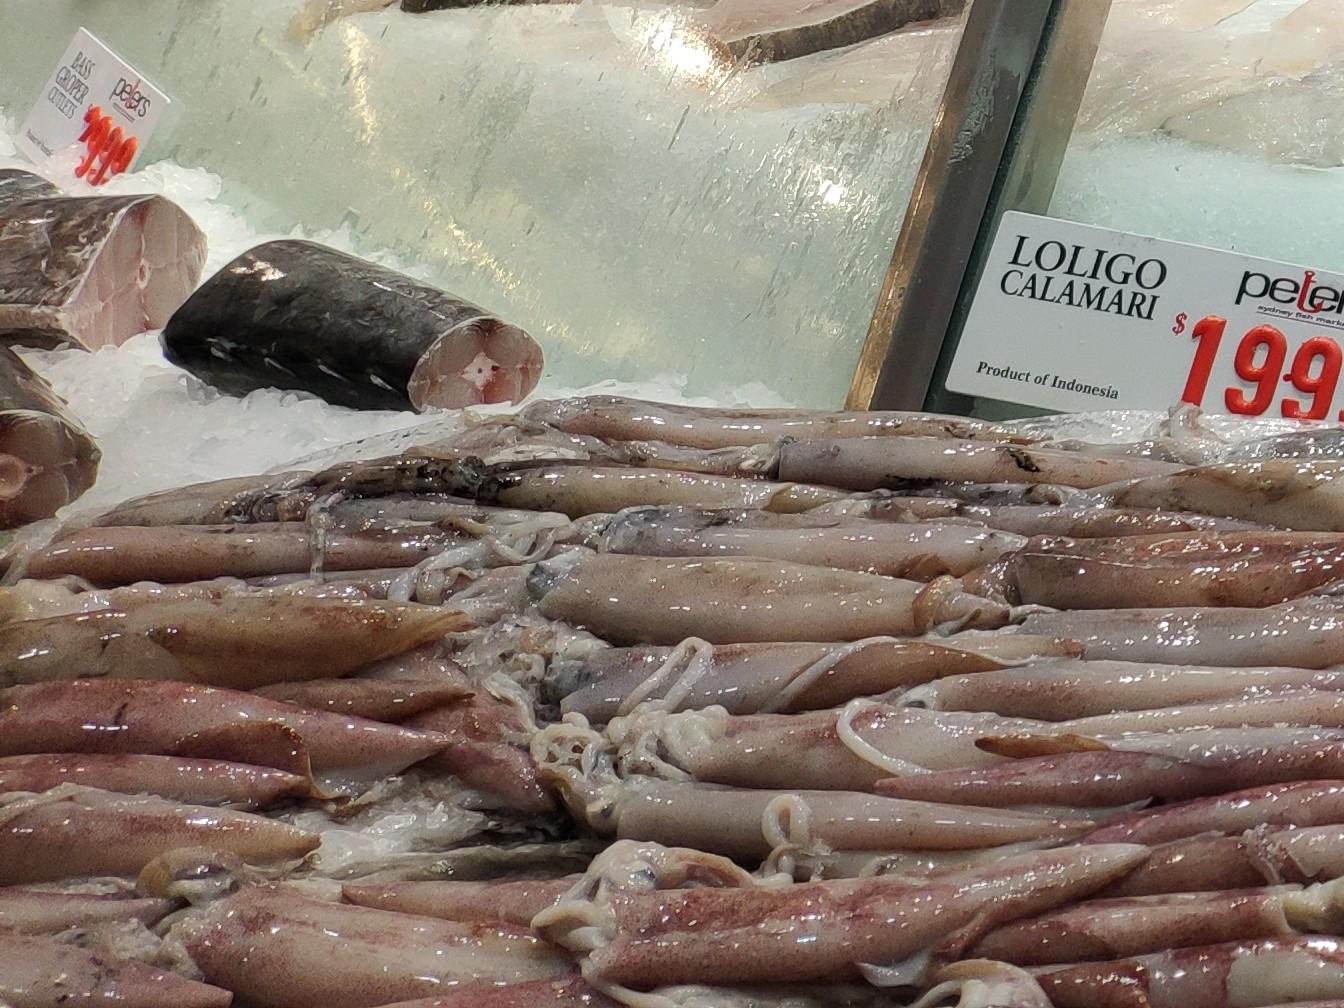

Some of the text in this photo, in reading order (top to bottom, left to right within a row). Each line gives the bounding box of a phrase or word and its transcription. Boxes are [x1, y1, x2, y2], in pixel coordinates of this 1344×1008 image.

[55, 65, 90, 105] GROPER
[71, 51, 97, 80] BASS
[1007, 235, 1168, 290] LOLIGO
[1000, 269, 1160, 321] CALAMARI
[976, 360, 1121, 401] Product of Indonesia
